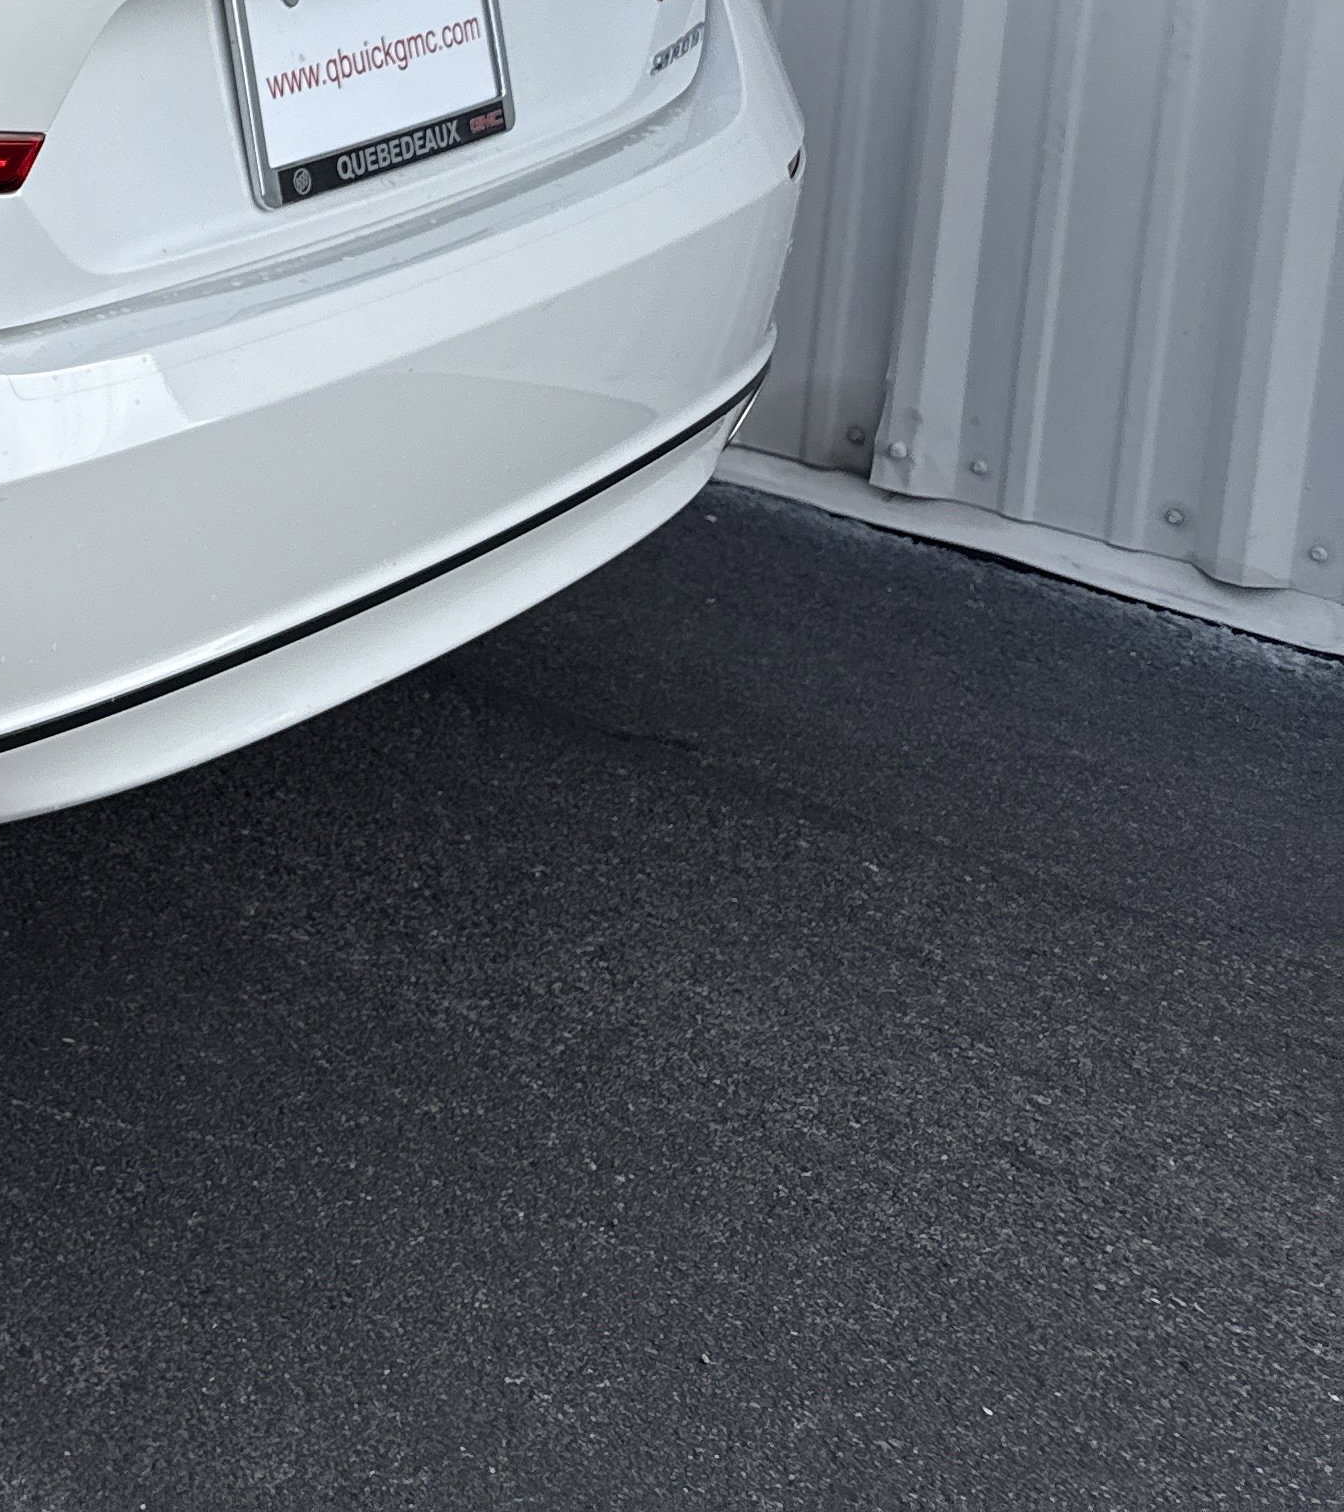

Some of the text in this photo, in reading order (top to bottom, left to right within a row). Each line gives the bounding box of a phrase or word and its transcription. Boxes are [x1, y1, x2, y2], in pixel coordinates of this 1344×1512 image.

[265, 16, 482, 100] www.qbuickgmc.com
[336, 108, 504, 181] QUEBEDEAUX GMC
